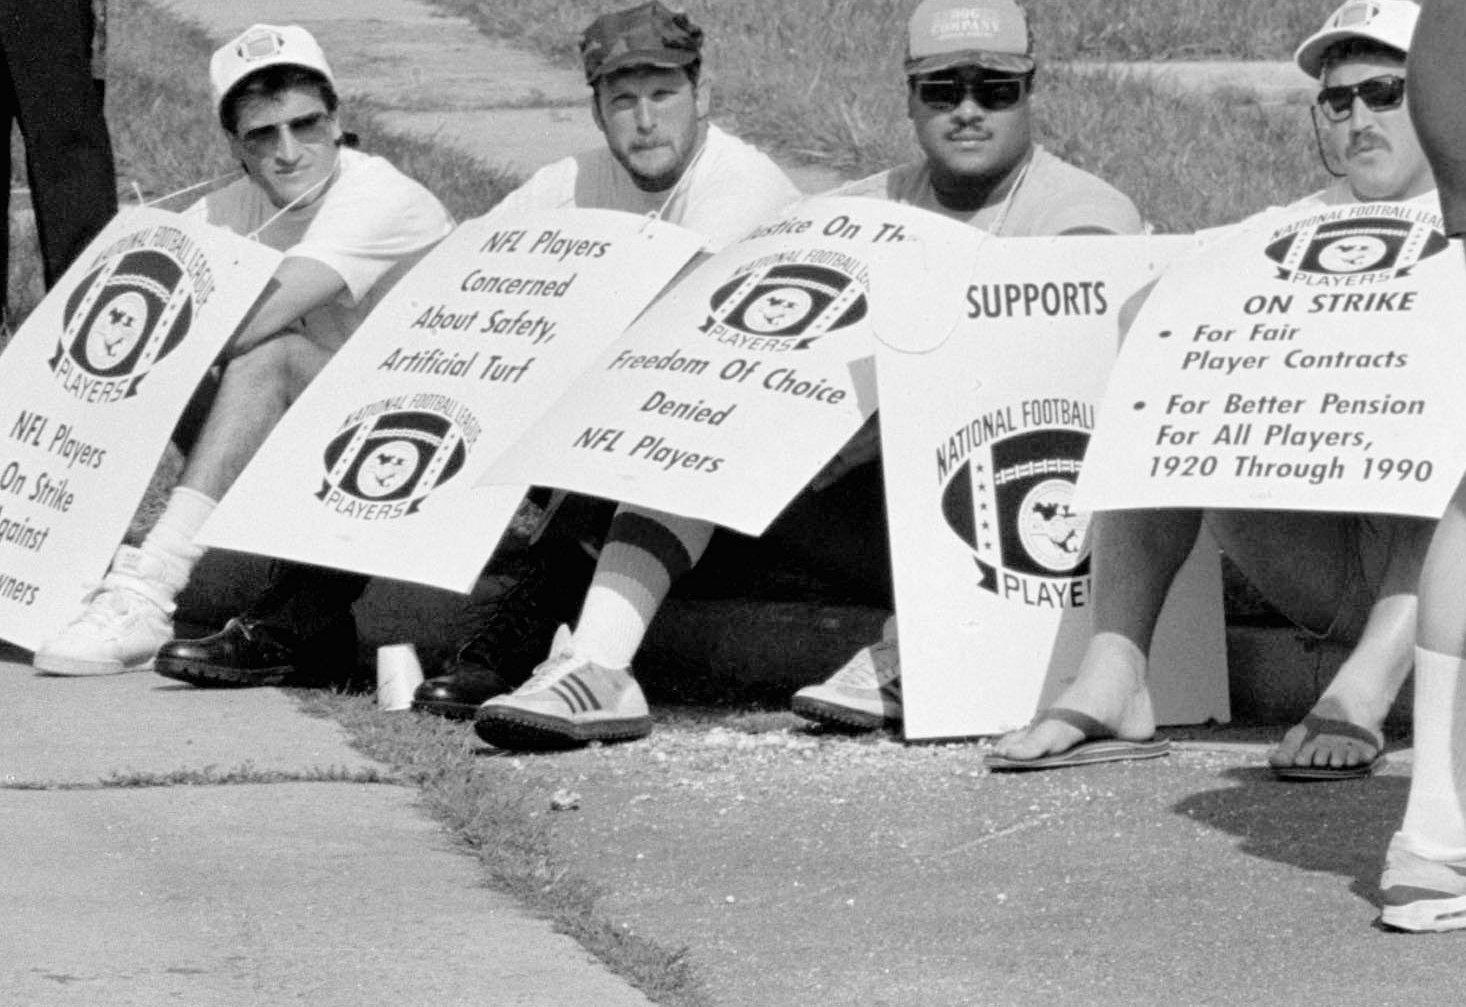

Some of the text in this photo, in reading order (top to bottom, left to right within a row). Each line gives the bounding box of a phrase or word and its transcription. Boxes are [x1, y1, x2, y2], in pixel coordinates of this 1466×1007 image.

[823, 215, 862, 240] On
[1270, 210, 1343, 241] NATIONAL
[1349, 204, 1413, 219] FOOTBALL
[480, 229, 611, 262] NFL Players
[803, 248, 862, 275] FOOTBALL
[460, 269, 577, 297] Concerned
[1292, 272, 1391, 287] PLAYERS
[966, 281, 1108, 319] SUPPORTS
[1243, 292, 1418, 314] ON STRIKE
[410, 304, 557, 345] About Safety,
[708, 325, 798, 352] PLAYERS
[1192, 324, 1301, 343] For Fair
[377, 347, 536, 383] Artificial Turf
[607, 349, 847, 405] Freedom Of Choice
[1180, 349, 1408, 375] Player Contracts
[56, 356, 129, 403] PLAYERS
[639, 391, 737, 426] Denied
[1166, 393, 1426, 415] For Better Pension
[9, 410, 107, 469] NFL Players
[573, 427, 725, 474] NFL Players
[936, 405, 1017, 486] NATIONAL
[1155, 424, 1373, 450] For All Players,
[0, 461, 74, 513] On Strike
[1149, 456, 1433, 485] 1920 Through 1990
[326, 490, 408, 520] PLAYERS
[0, 505, 50, 551] gainst
[1003, 573, 1092, 609] PLAYE
